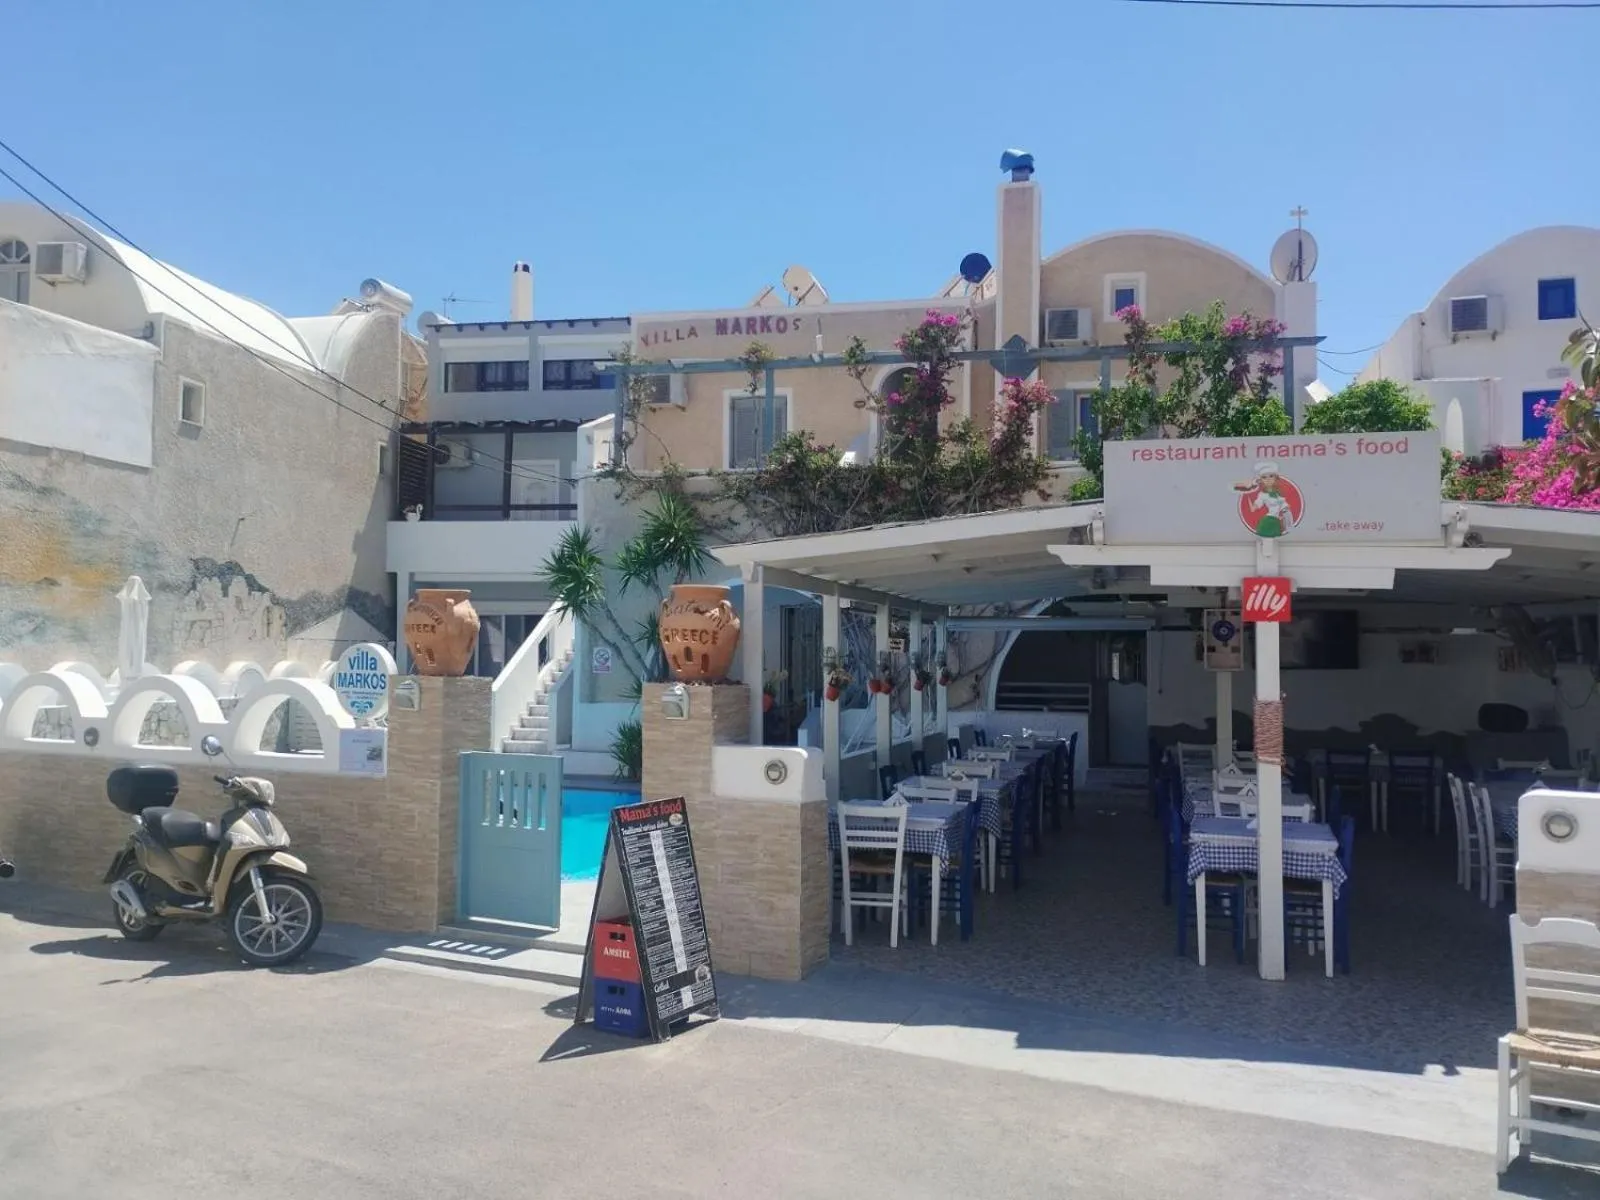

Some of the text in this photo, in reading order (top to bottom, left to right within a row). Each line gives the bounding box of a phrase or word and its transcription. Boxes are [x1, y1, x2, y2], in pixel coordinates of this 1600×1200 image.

[640, 315, 803, 347] VILLA MARKOS
[1132, 436, 1410, 462] restaurant mama's food
[1352, 520, 1385, 533] away
[1245, 583, 1288, 618] illy
[662, 627, 720, 646] GREECE
[348, 651, 378, 671] villa
[337, 672, 387, 690] MARKOS
[619, 799, 682, 823] Mama's food
[603, 946, 632, 959] AMSTEL
